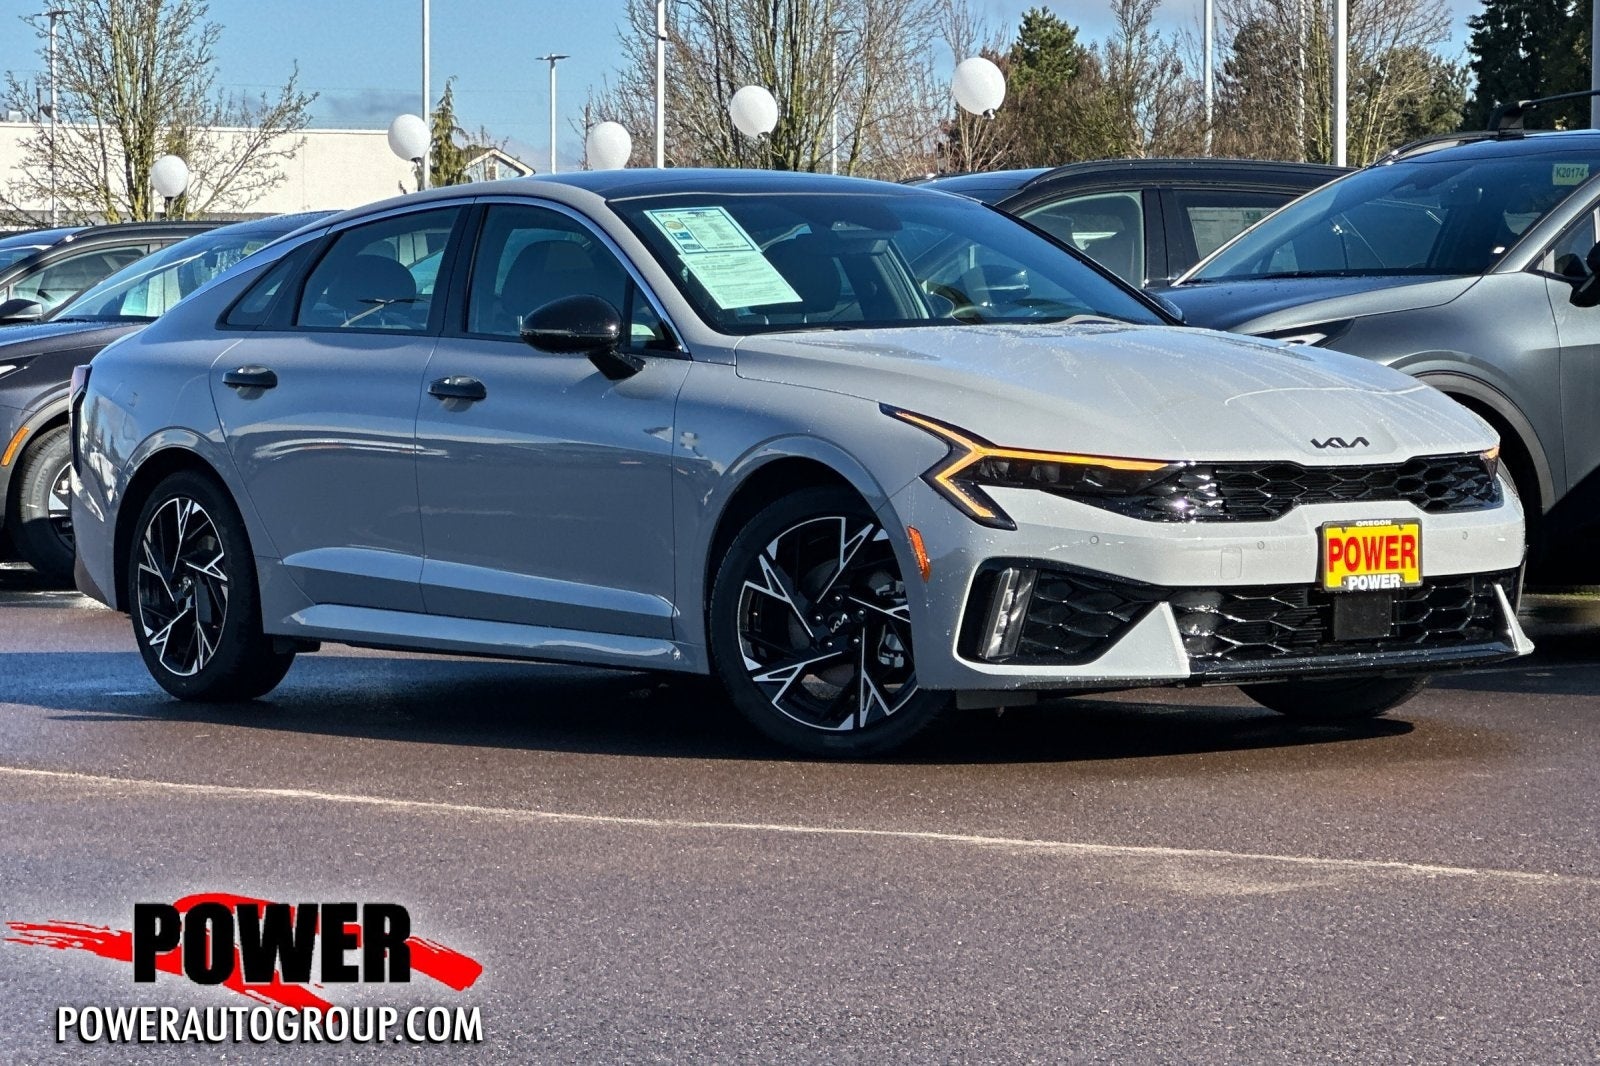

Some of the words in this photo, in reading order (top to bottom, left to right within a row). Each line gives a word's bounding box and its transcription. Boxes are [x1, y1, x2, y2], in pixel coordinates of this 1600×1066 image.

[1556, 167, 1586, 178] K20174
[1310, 437, 1370, 448] KIA
[1328, 534, 1417, 573] POWER
[1348, 574, 1401, 590] POWER
